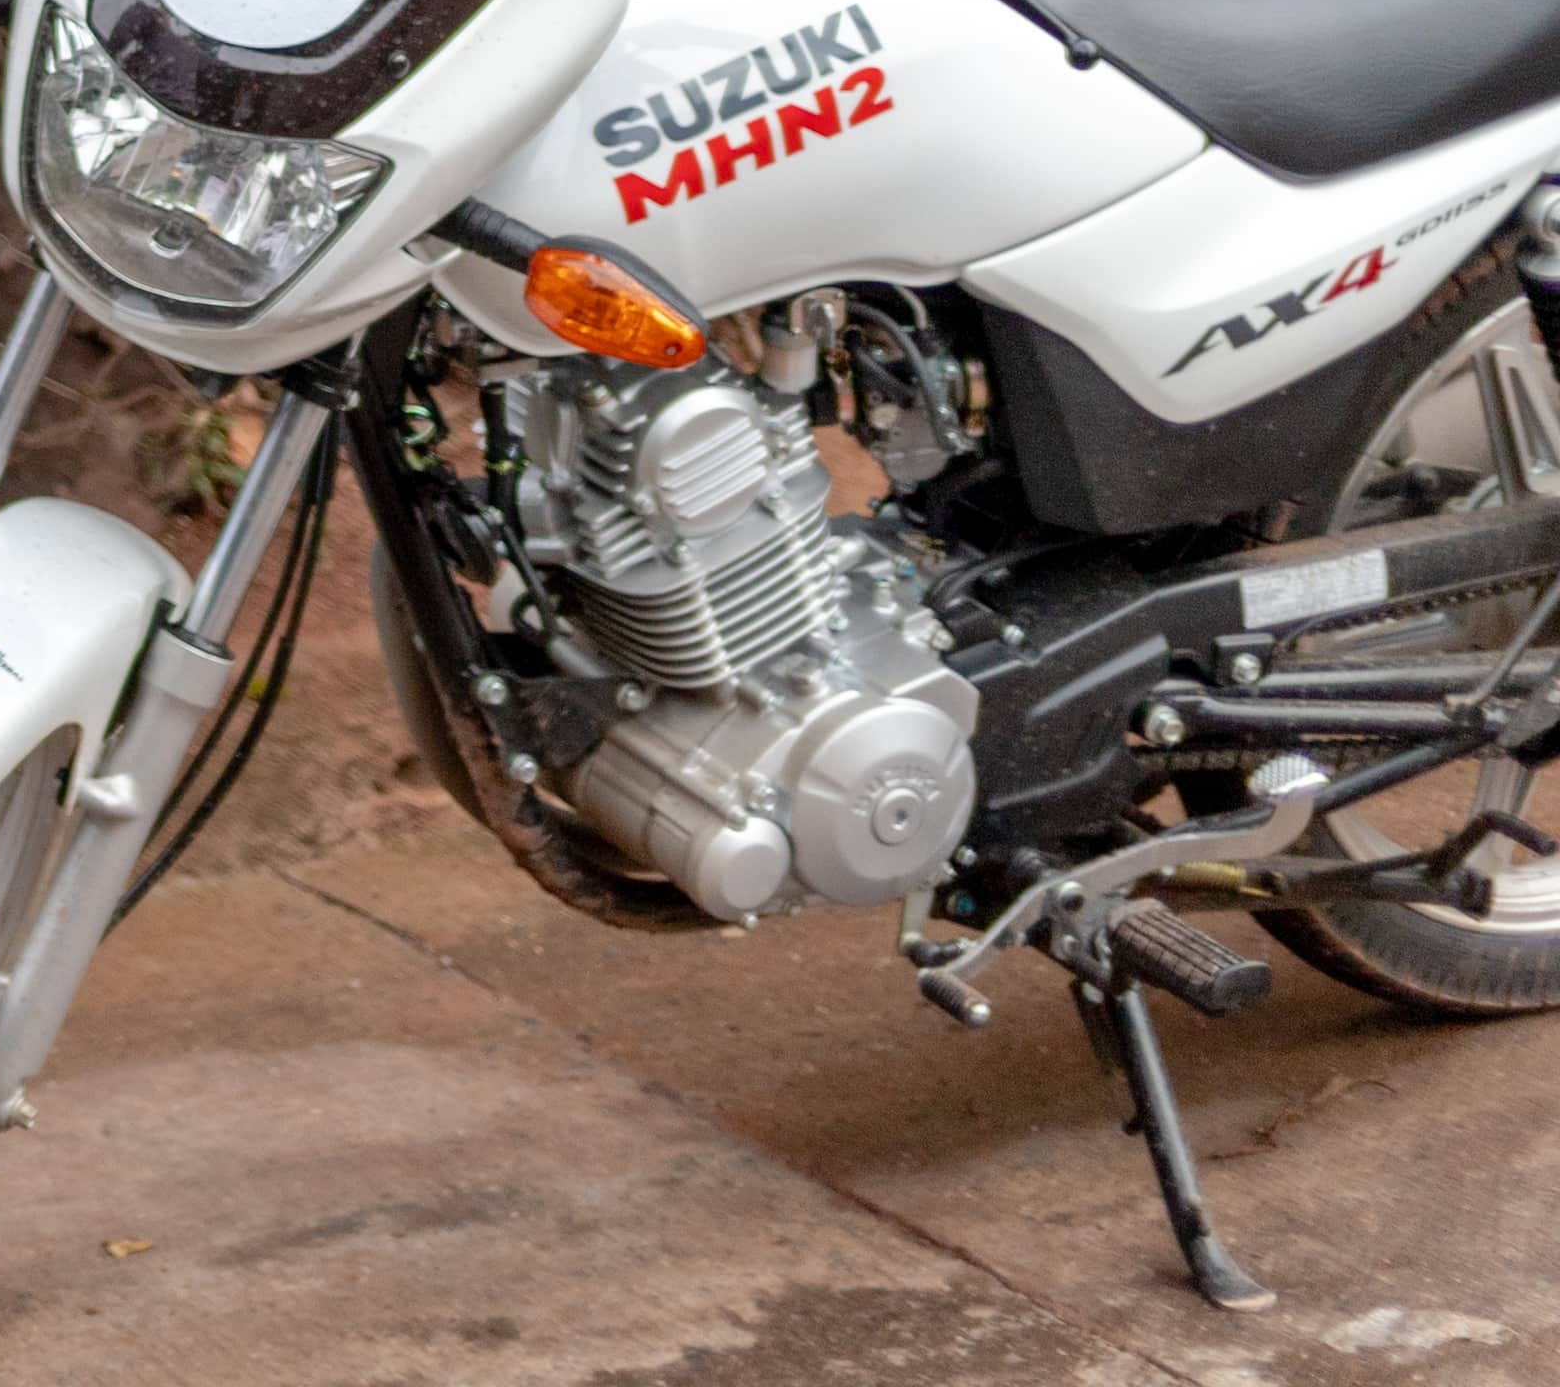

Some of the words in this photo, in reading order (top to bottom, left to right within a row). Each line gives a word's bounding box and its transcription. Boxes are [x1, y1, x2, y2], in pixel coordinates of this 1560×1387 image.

[592, 3, 883, 168] SUZUKI
[614, 66, 894, 226] MHN2
[1161, 244, 1400, 378] AX4
